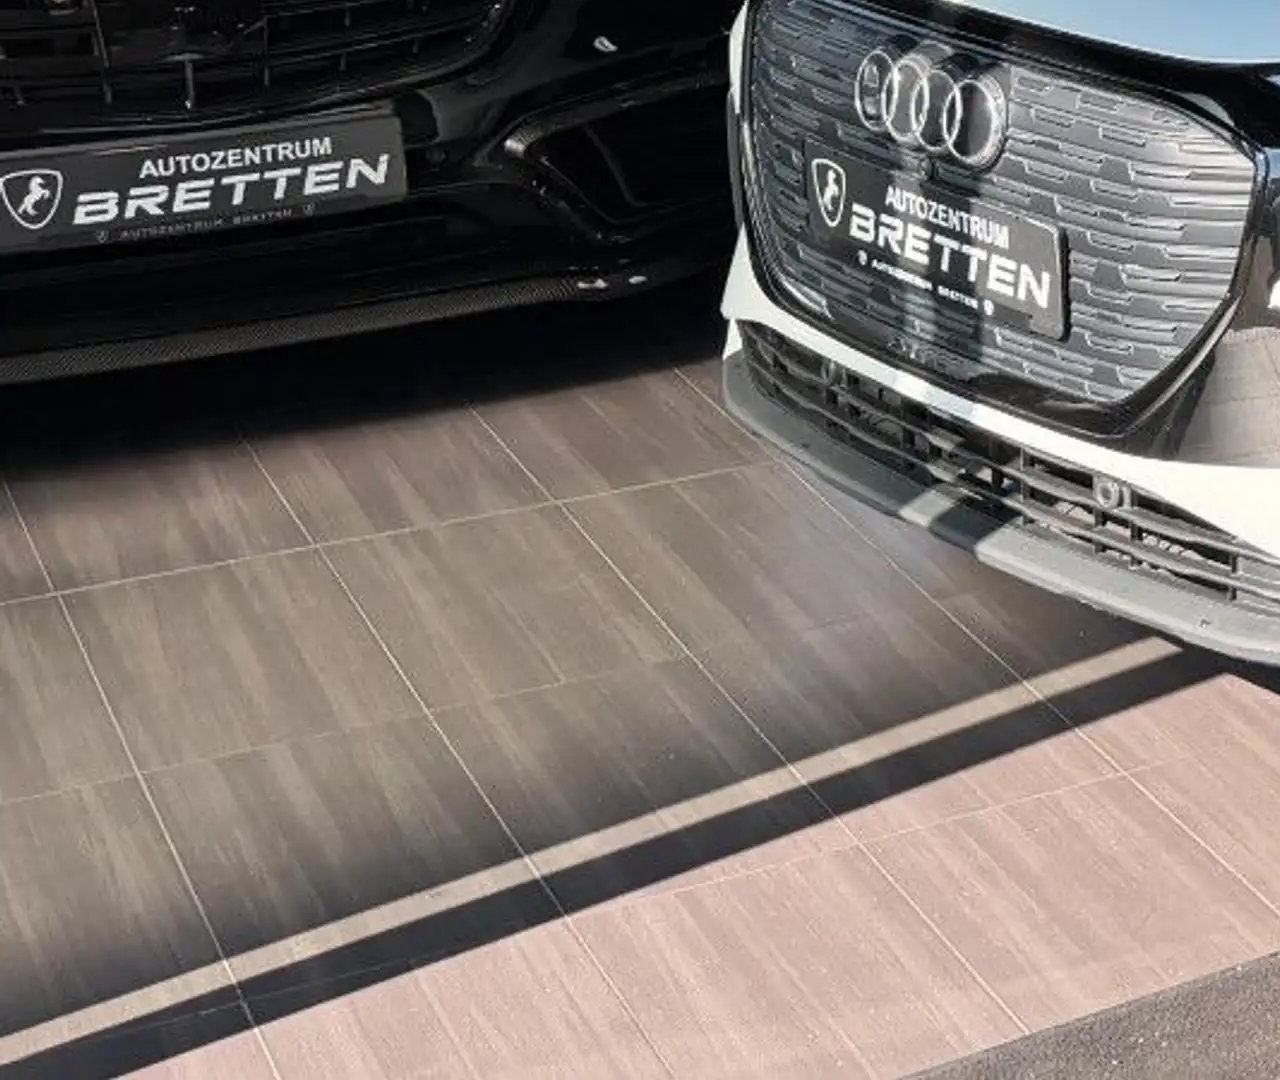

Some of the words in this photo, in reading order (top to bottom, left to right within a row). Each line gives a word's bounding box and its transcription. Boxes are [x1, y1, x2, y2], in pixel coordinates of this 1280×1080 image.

[72, 153, 390, 226] BRETTEN
[138, 136, 333, 179] AUTOZENTRUM
[885, 185, 1009, 249] AUTOZENTRUM
[850, 202, 1051, 309] BRETTEN
